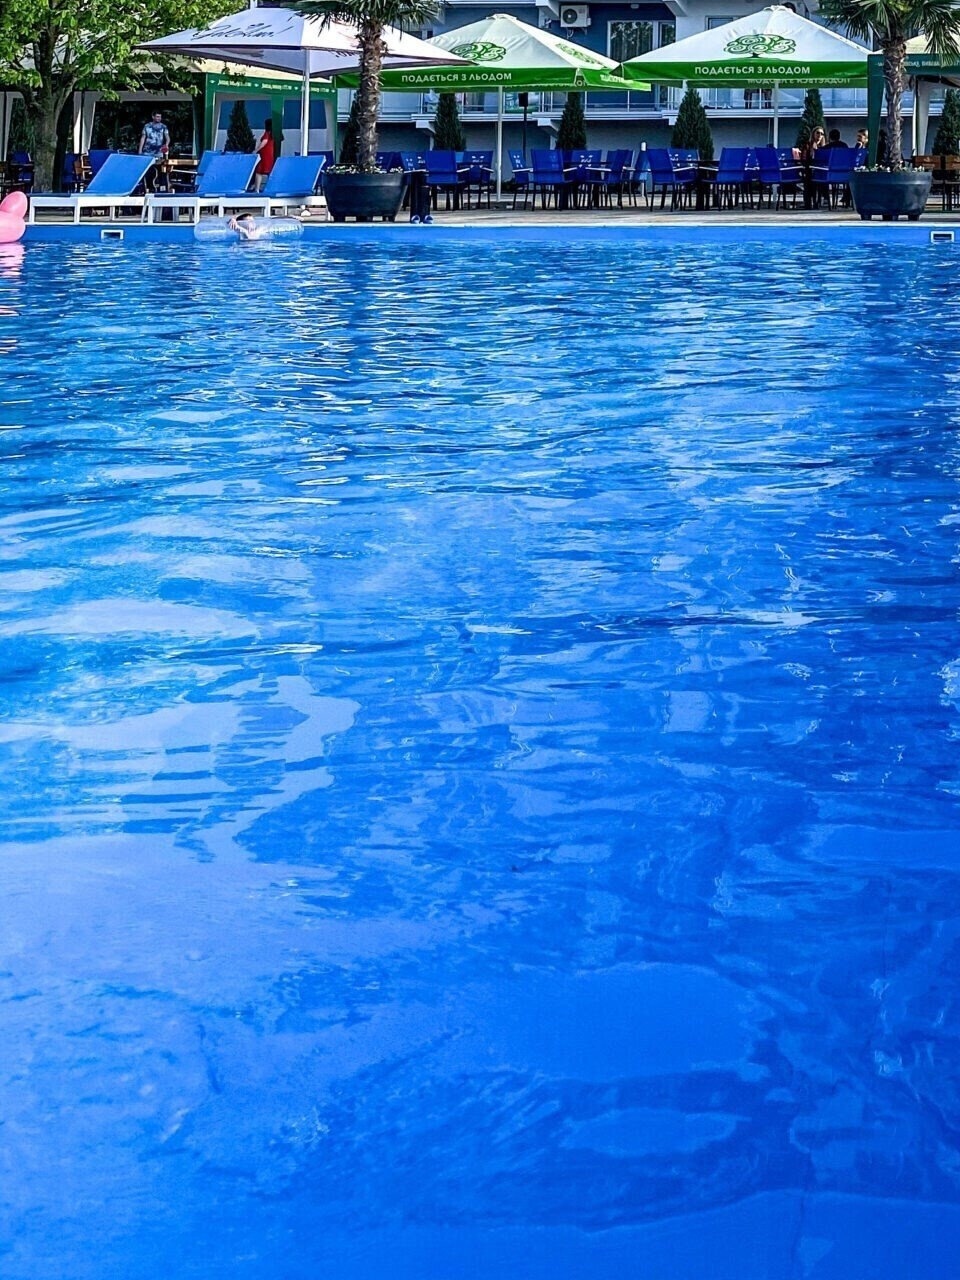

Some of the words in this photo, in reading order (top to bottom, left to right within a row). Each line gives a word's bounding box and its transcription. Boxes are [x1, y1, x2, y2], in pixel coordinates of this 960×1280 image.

[695, 66, 754, 75] ПОДАЄТЬСЯ
[757, 66, 763, 74] З
[766, 66, 810, 74] ЛЬОДОМ
[401, 75, 459, 83] ПОДАЄТЬСЯ
[468, 73, 512, 81] ЛЬОДОМ
